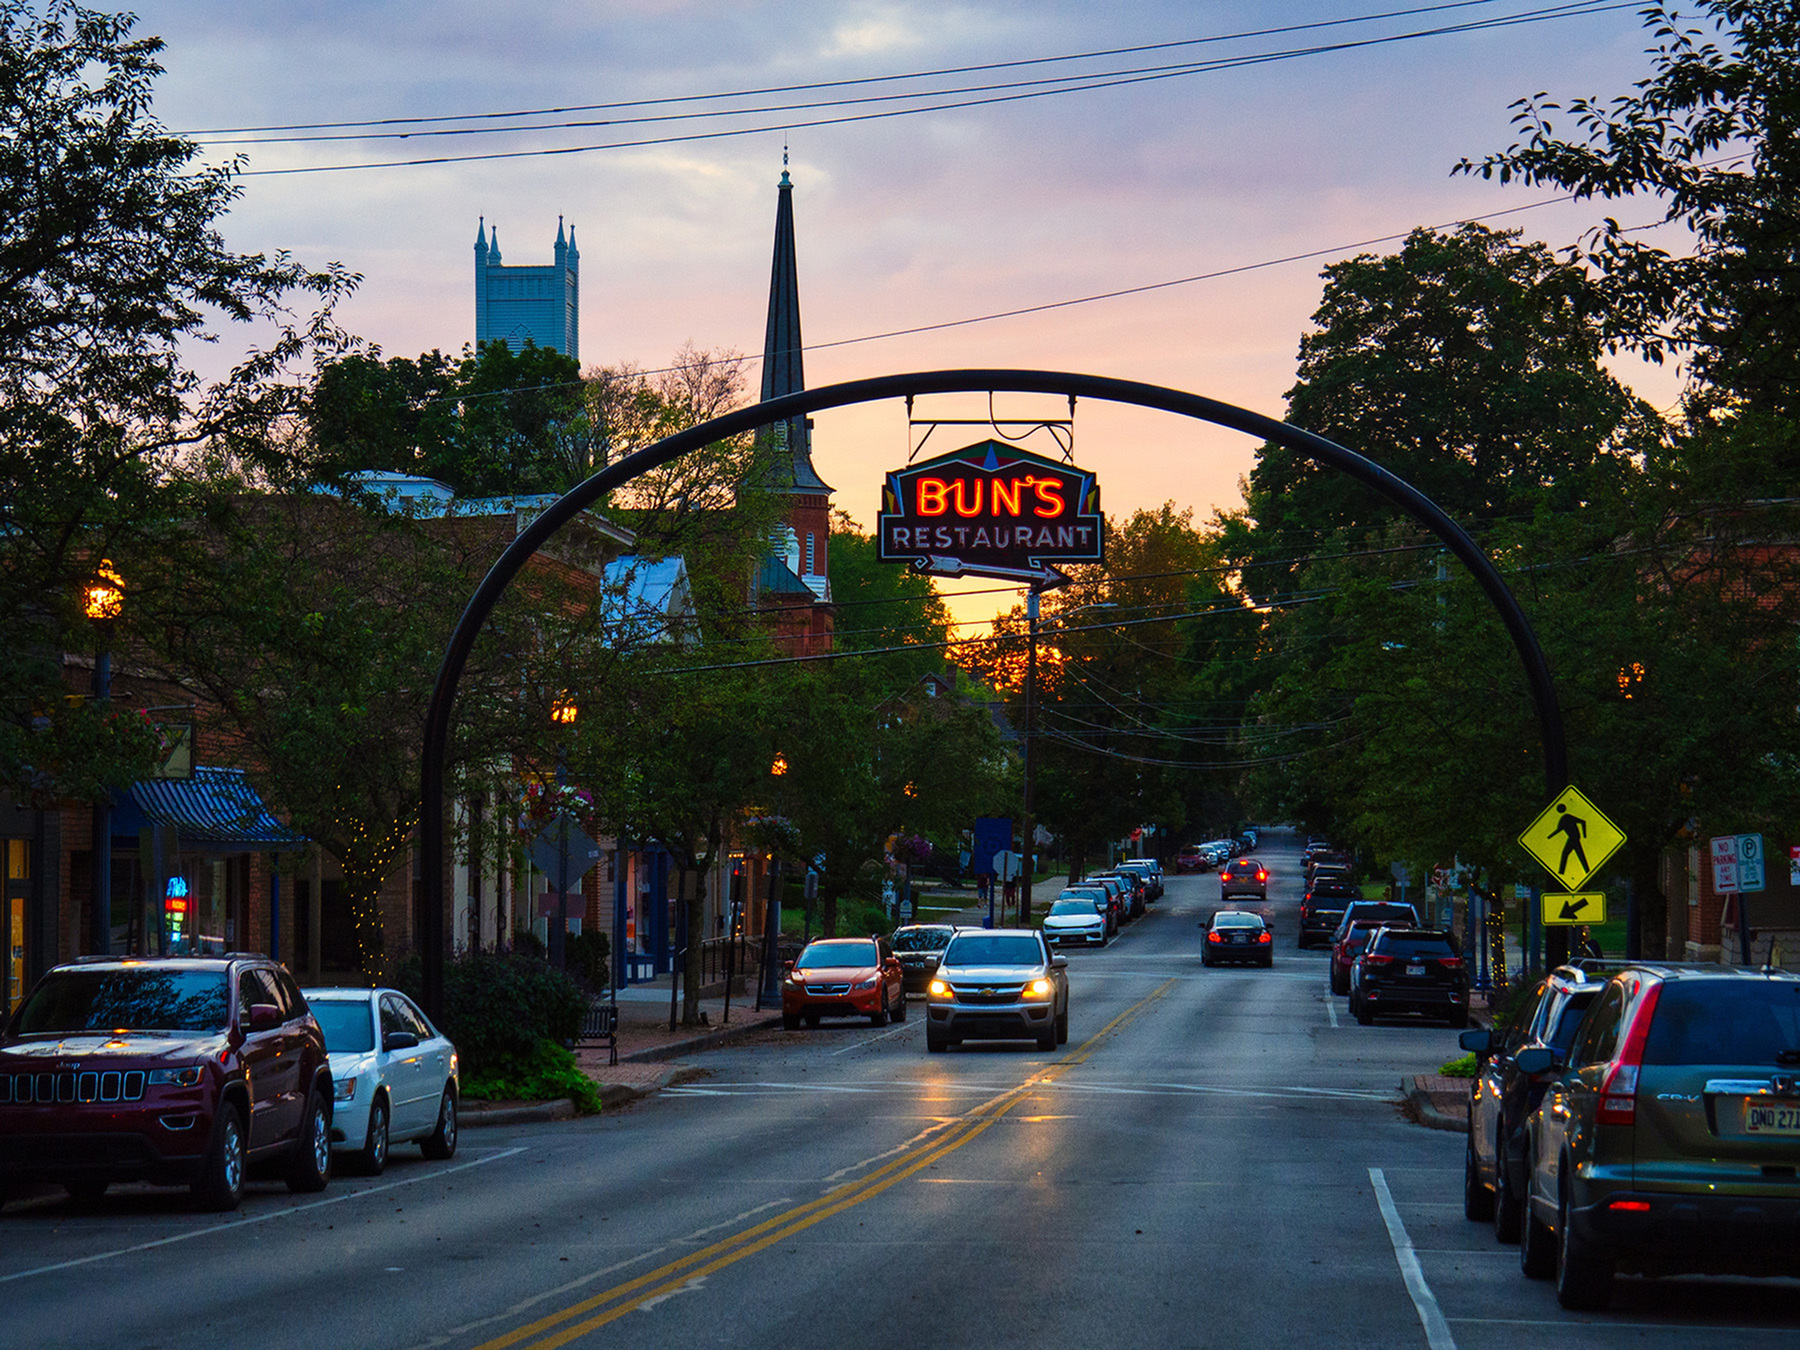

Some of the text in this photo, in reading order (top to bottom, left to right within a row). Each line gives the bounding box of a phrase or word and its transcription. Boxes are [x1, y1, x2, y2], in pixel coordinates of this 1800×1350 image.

[917, 474, 1065, 518] BUN'S
[892, 526, 1092, 548] RESTAURANT
[1718, 841, 1728, 852] NO
[1713, 853, 1737, 865] PARKING
[1720, 873, 1733, 881] TIME
